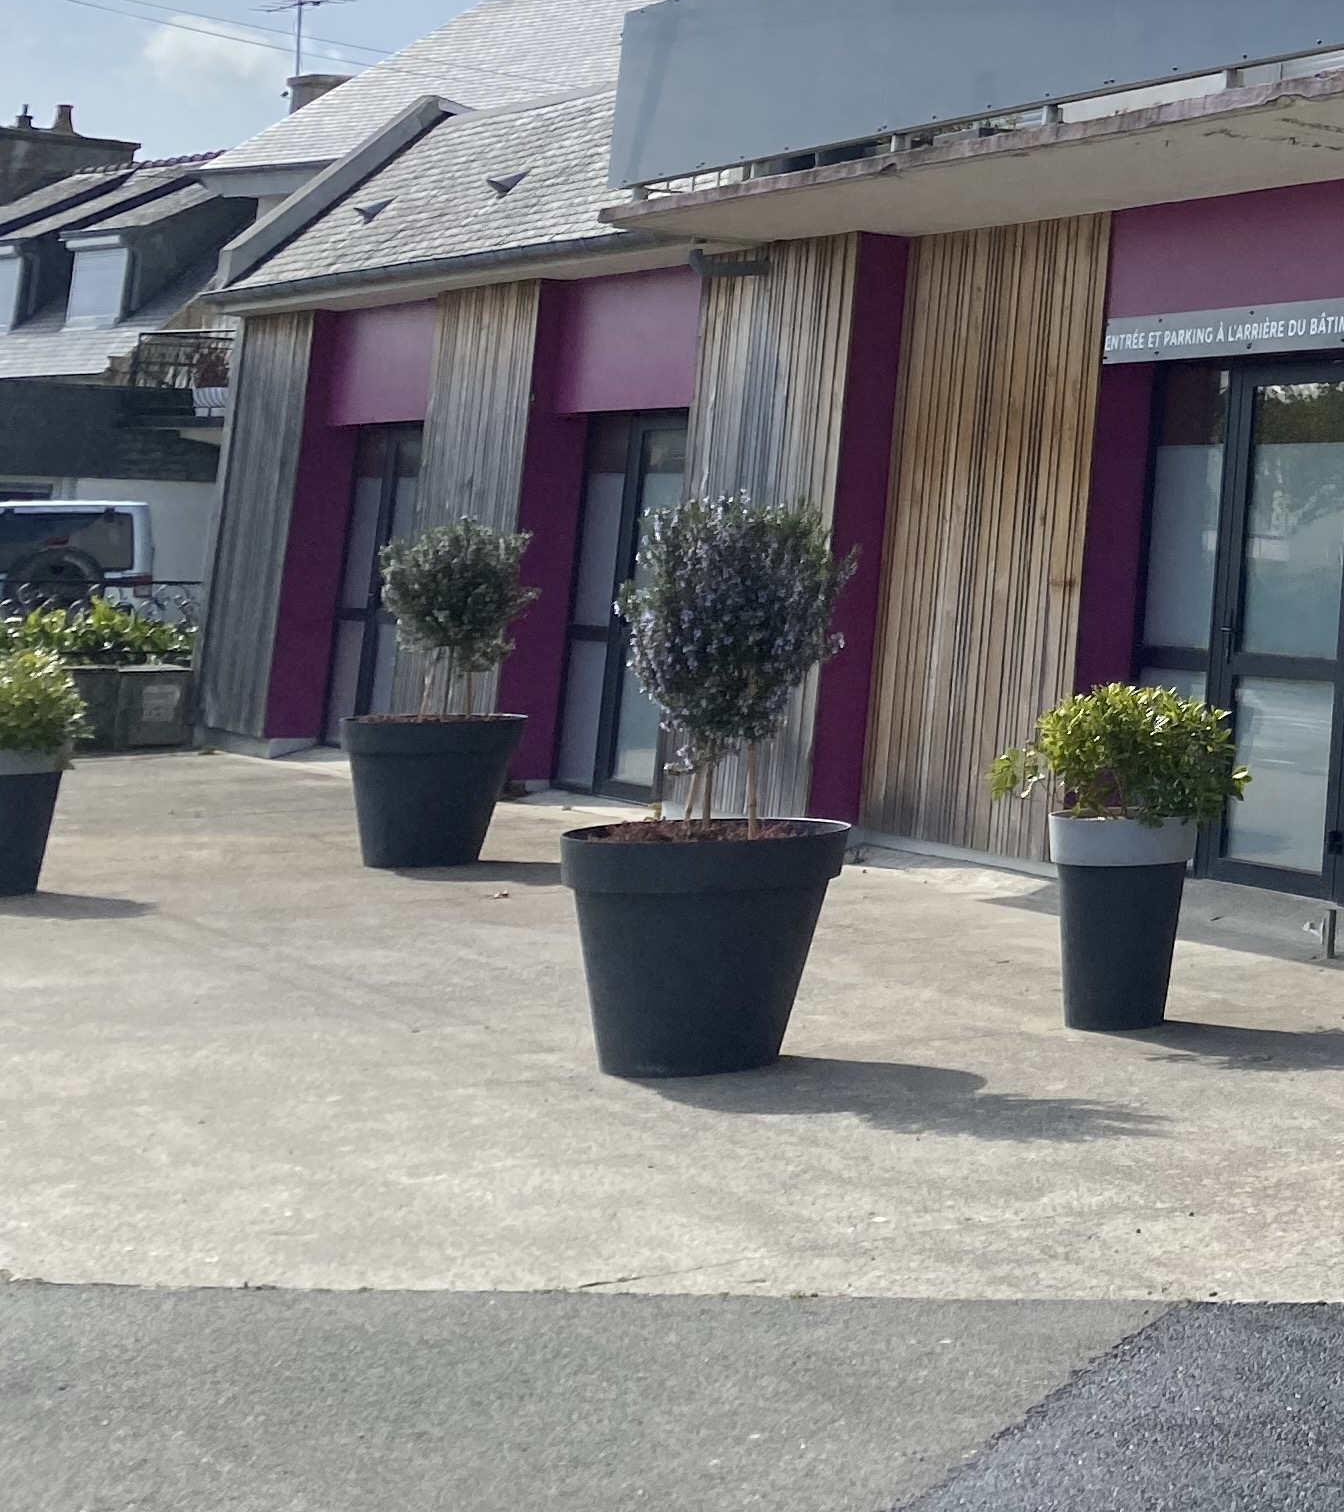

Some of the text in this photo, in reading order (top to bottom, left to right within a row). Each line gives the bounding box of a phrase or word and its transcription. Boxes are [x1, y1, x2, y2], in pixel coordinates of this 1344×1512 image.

[1104, 331, 1145, 352] ENTRÉE
[1148, 330, 1163, 348] ET
[1163, 327, 1213, 346] PARKING
[1216, 321, 1225, 342] À
[1287, 318, 1307, 335] DU
